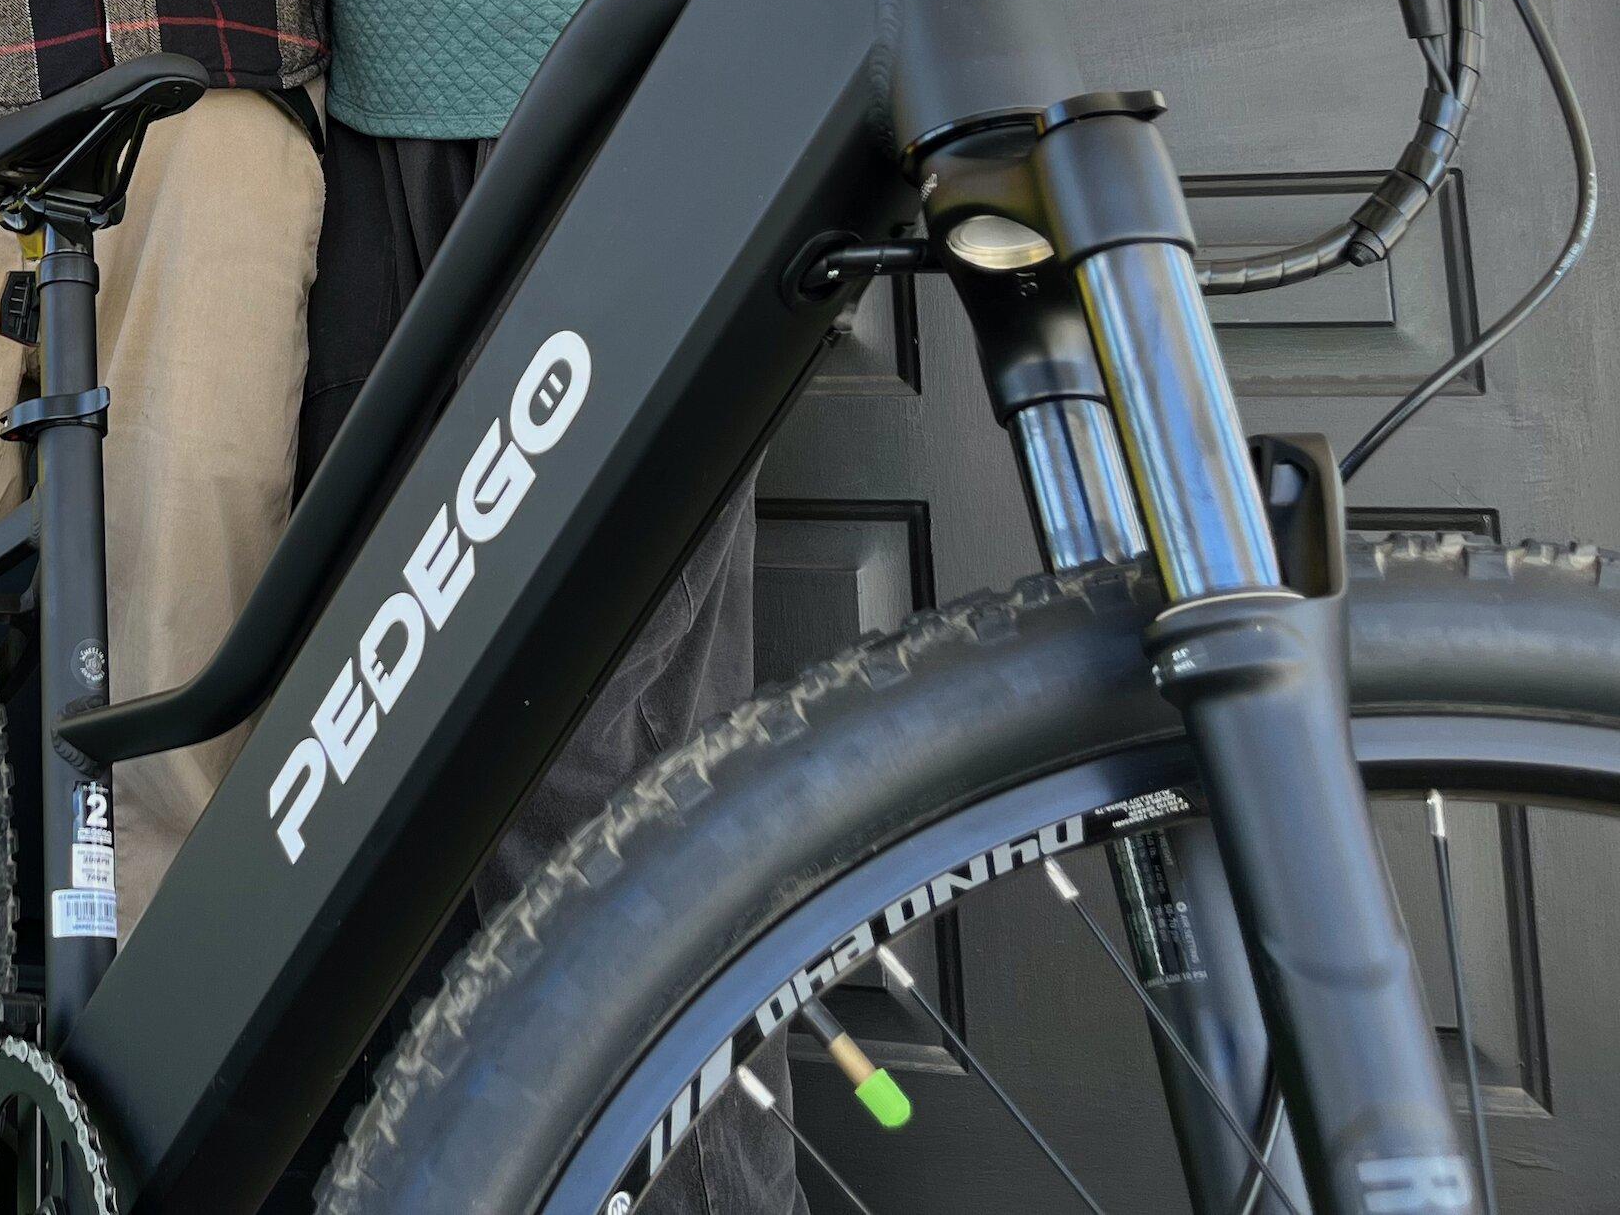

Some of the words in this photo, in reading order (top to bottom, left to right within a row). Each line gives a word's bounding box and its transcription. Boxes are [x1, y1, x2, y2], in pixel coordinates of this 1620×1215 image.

[269, 329, 593, 866] PEDEGO
[86, 793, 108, 828] 2
[882, 812, 1085, 936] DYNO
